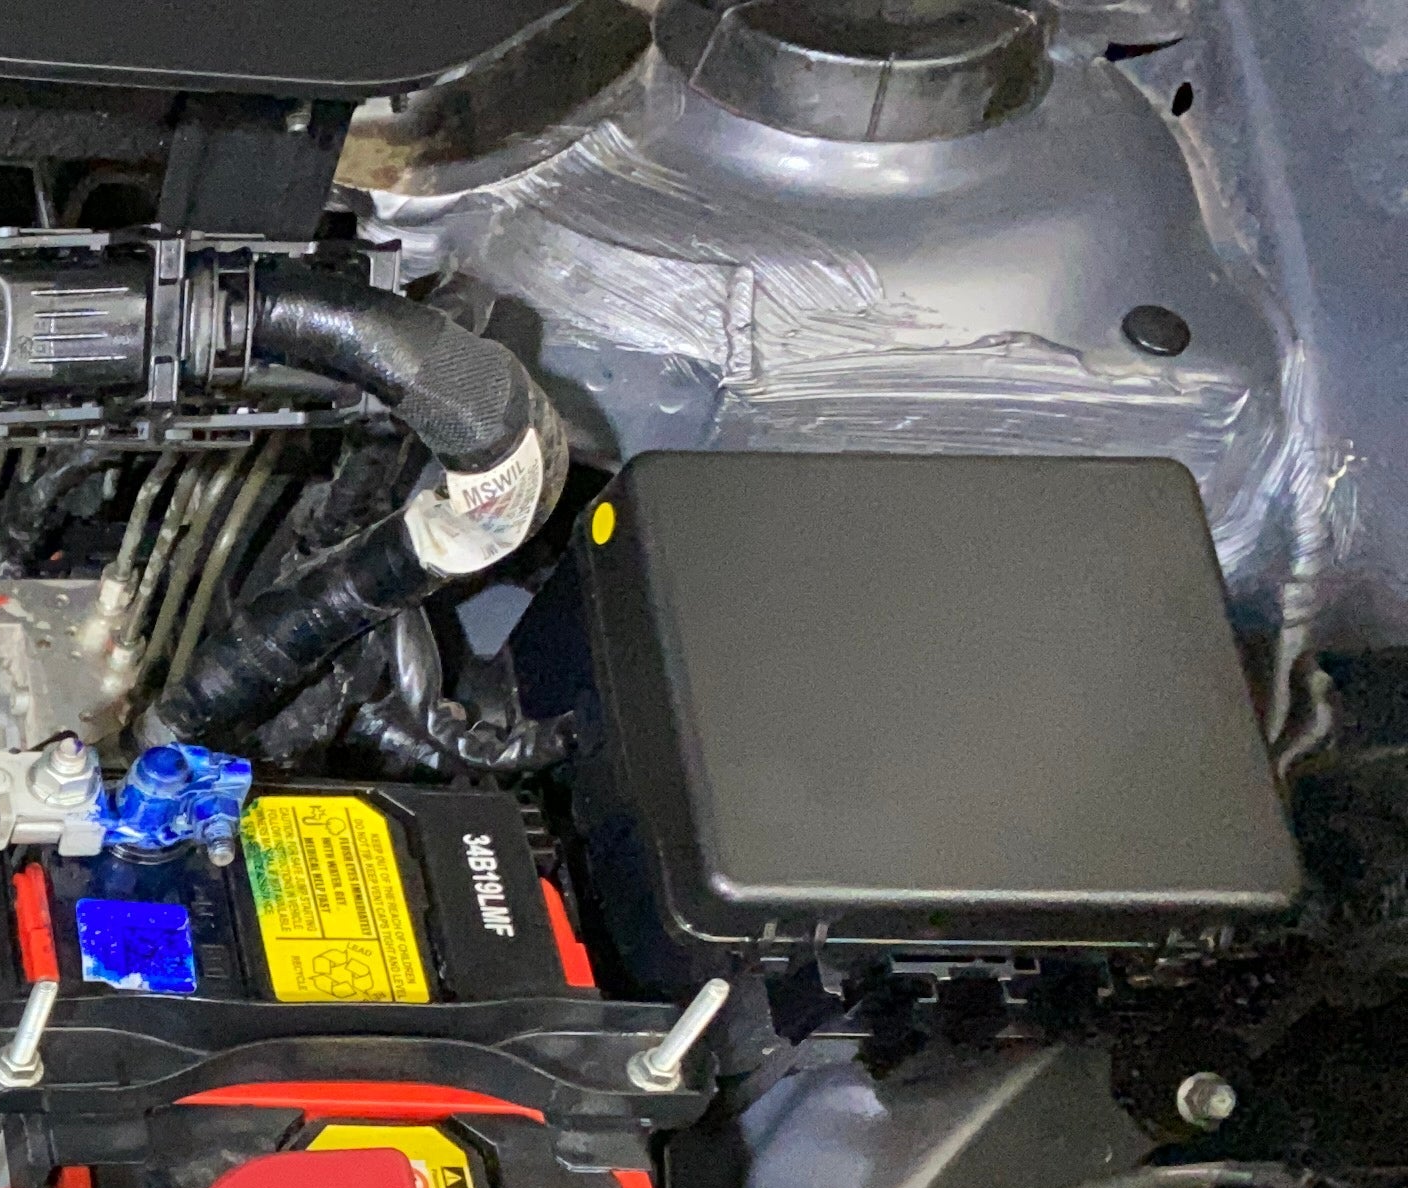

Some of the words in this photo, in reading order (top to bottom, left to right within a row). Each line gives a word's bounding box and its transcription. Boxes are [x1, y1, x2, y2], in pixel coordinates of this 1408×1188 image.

[462, 460, 525, 509] MSWIL
[353, 818, 364, 829] DO
[338, 837, 353, 861] FLUSH
[356, 831, 369, 847] NOT
[369, 833, 383, 853] KEEP
[303, 837, 320, 870] MEDICAL
[375, 855, 387, 871] OUT
[321, 837, 334, 858] WITH
[334, 891, 346, 905] GET
[345, 864, 358, 881] EYES
[365, 863, 378, 884] KEEP
[380, 872, 390, 882] OF
[312, 873, 325, 891] HELP
[462, 834, 515, 936] 34B19LMF
[317, 894, 330, 911] FAST
[371, 886, 383, 905] VENT
[350, 883, 371, 935] IMMEDIATELY
[375, 907, 389, 928] CAPS
[387, 902, 402, 928] REACH
[381, 931, 395, 953] TIGHT
[395, 931, 405, 942] OF
[291, 956, 307, 990] RECYCLE
[388, 956, 400, 972] AND
[398, 944, 416, 983] CHILDREN
[392, 974, 407, 998] LEVEL
